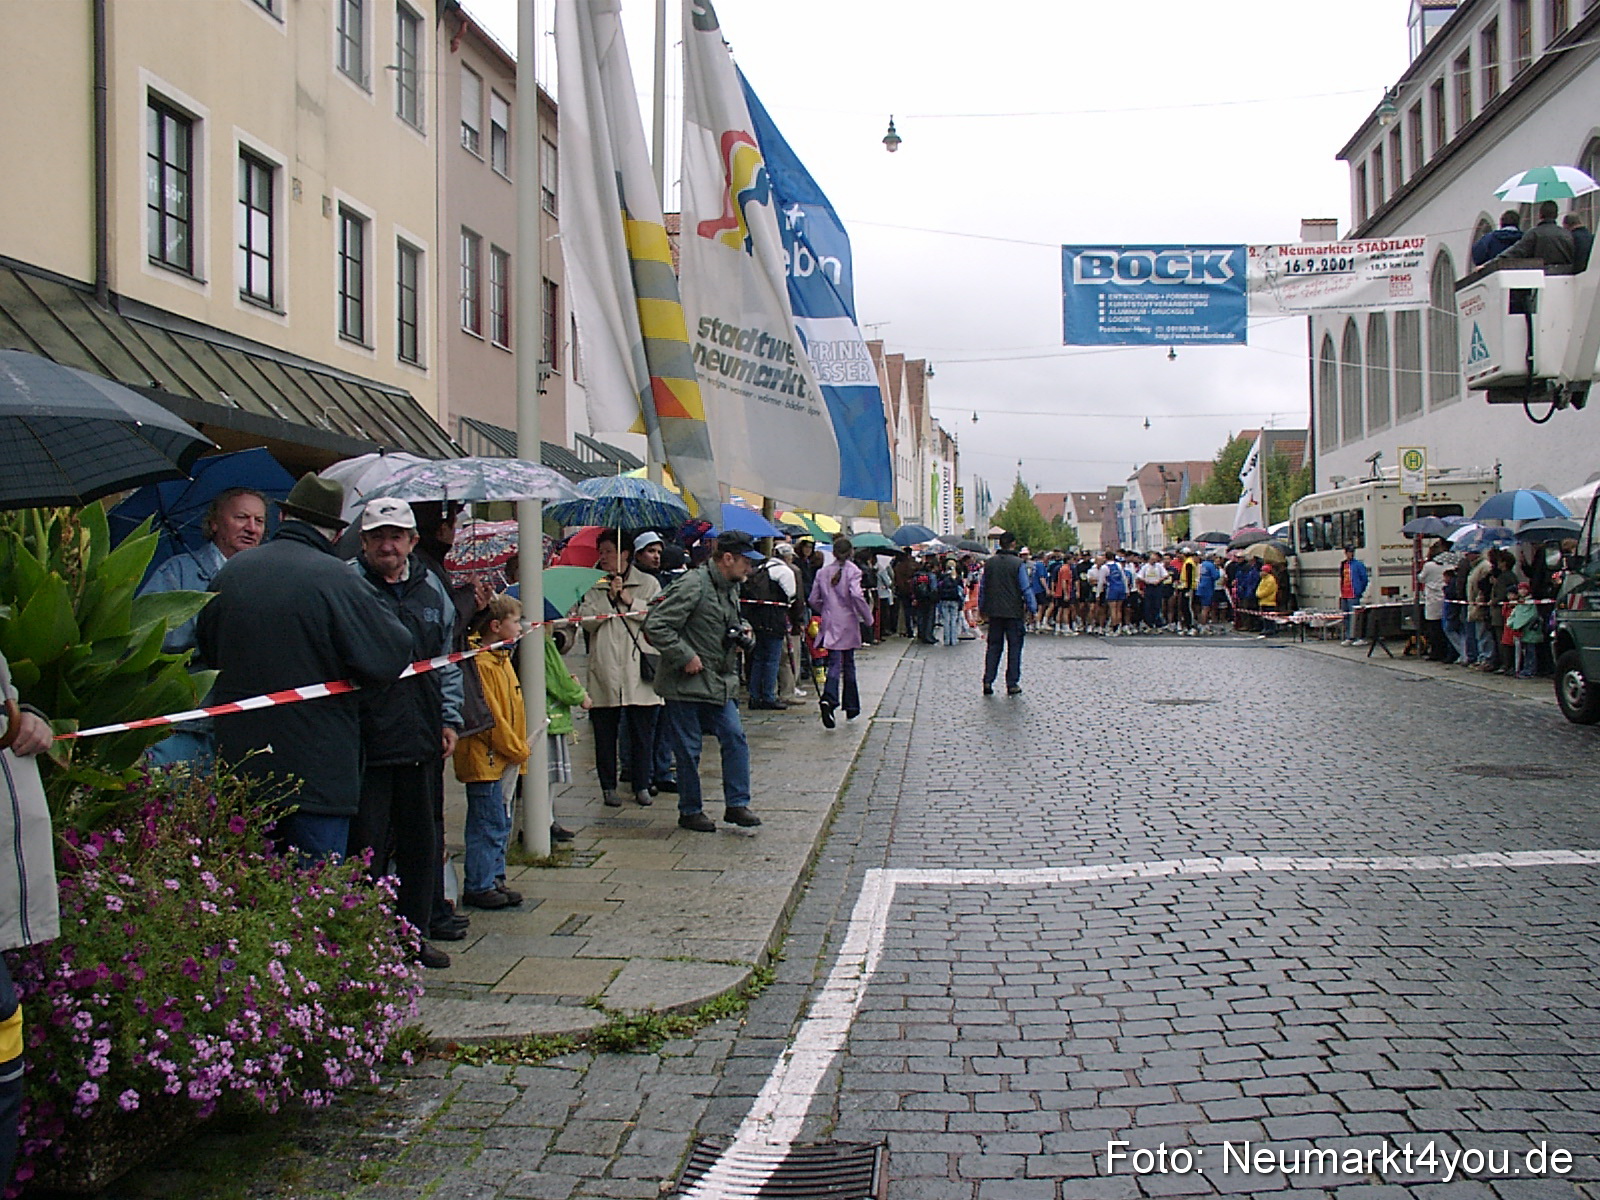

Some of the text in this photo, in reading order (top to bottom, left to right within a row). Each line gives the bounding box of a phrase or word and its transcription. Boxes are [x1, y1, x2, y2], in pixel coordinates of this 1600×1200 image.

[1248, 237, 1426, 258] 2. Neumarkter STADTLAUF
[1073, 249, 1236, 285] BOCK
[1284, 257, 1356, 273] 16.9.2001
[697, 316, 799, 368] stadtwe
[809, 340, 868, 361] TRINK
[692, 342, 807, 399] neumarkt
